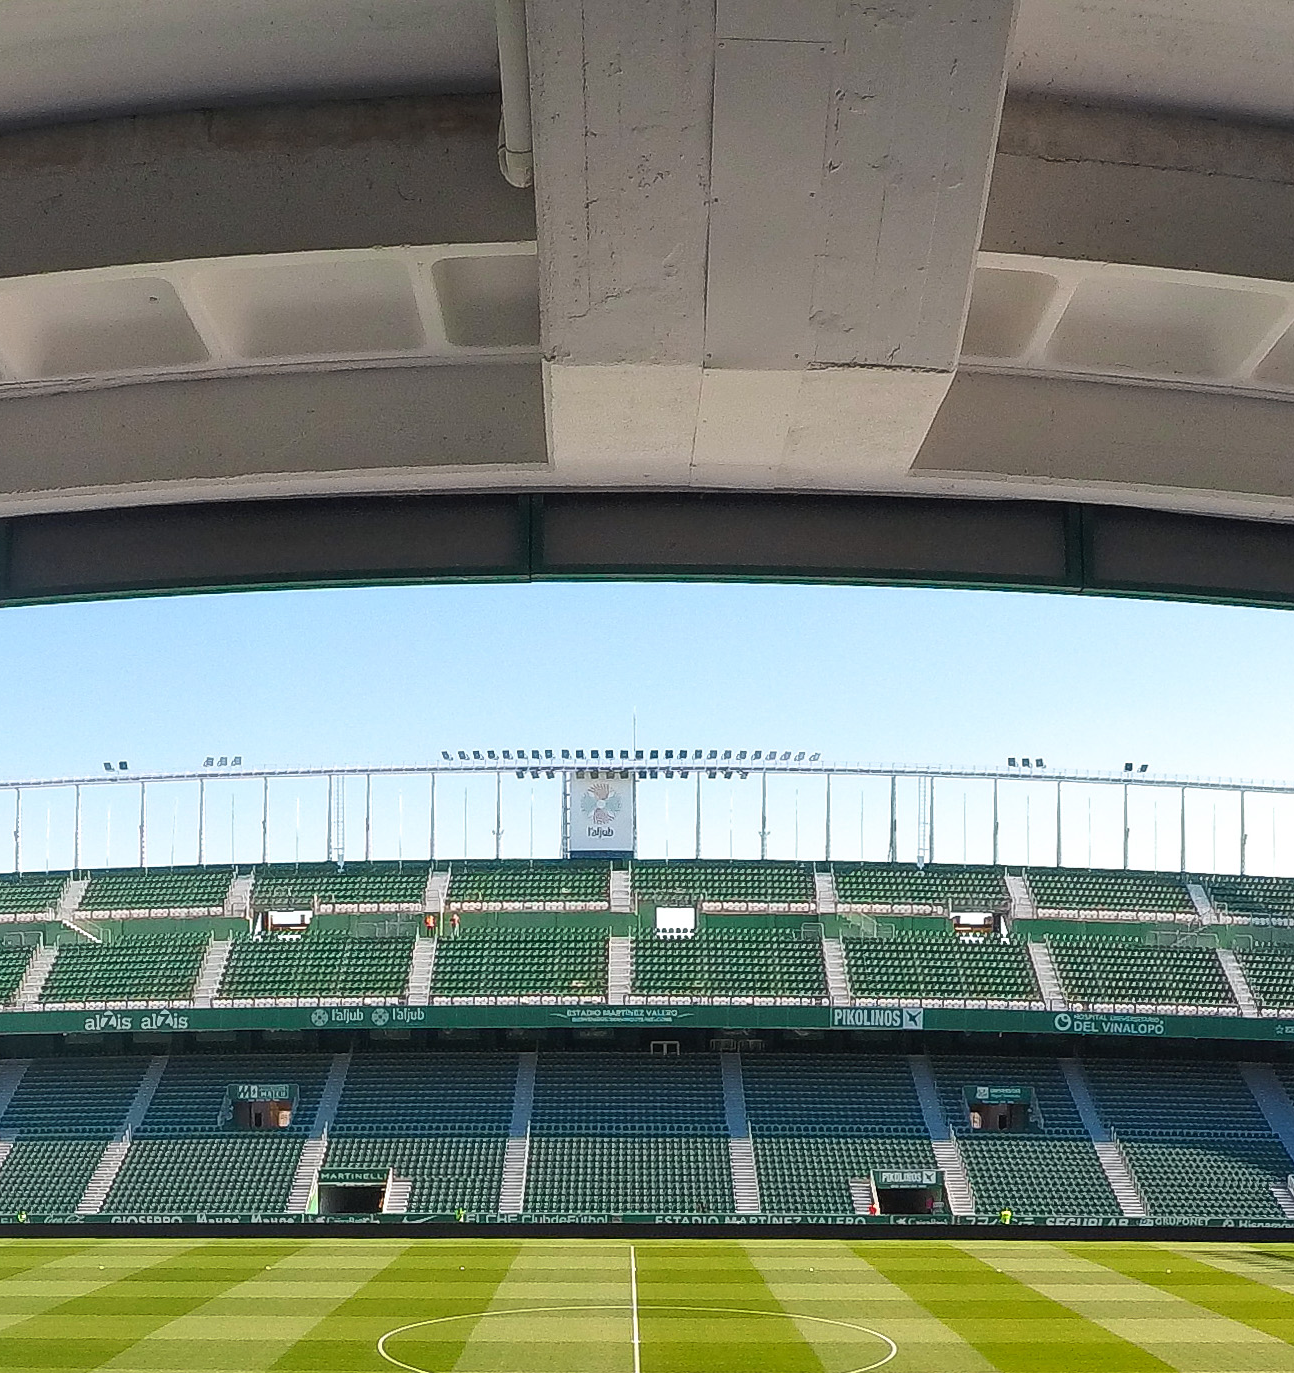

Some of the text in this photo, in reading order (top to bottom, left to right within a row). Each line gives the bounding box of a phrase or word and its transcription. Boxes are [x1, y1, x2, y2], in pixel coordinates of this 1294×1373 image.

[566, 1009, 601, 1017] ESTADIO
[646, 1009, 678, 1017] VALERO
[833, 1008, 901, 1027] PIKOLINOS
[1073, 1013, 1108, 1021] HOSPITAL
[1073, 1021, 1099, 1032] DEL
[320, 1172, 387, 1180] MARTINELLI
[881, 1172, 922, 1183] PIKOLINOS
[111, 1216, 183, 1224] GIOSEPPO
[465, 1214, 518, 1224] ELCHE
[656, 1216, 718, 1224] ESTADIO
[806, 1216, 867, 1225] VALERO
